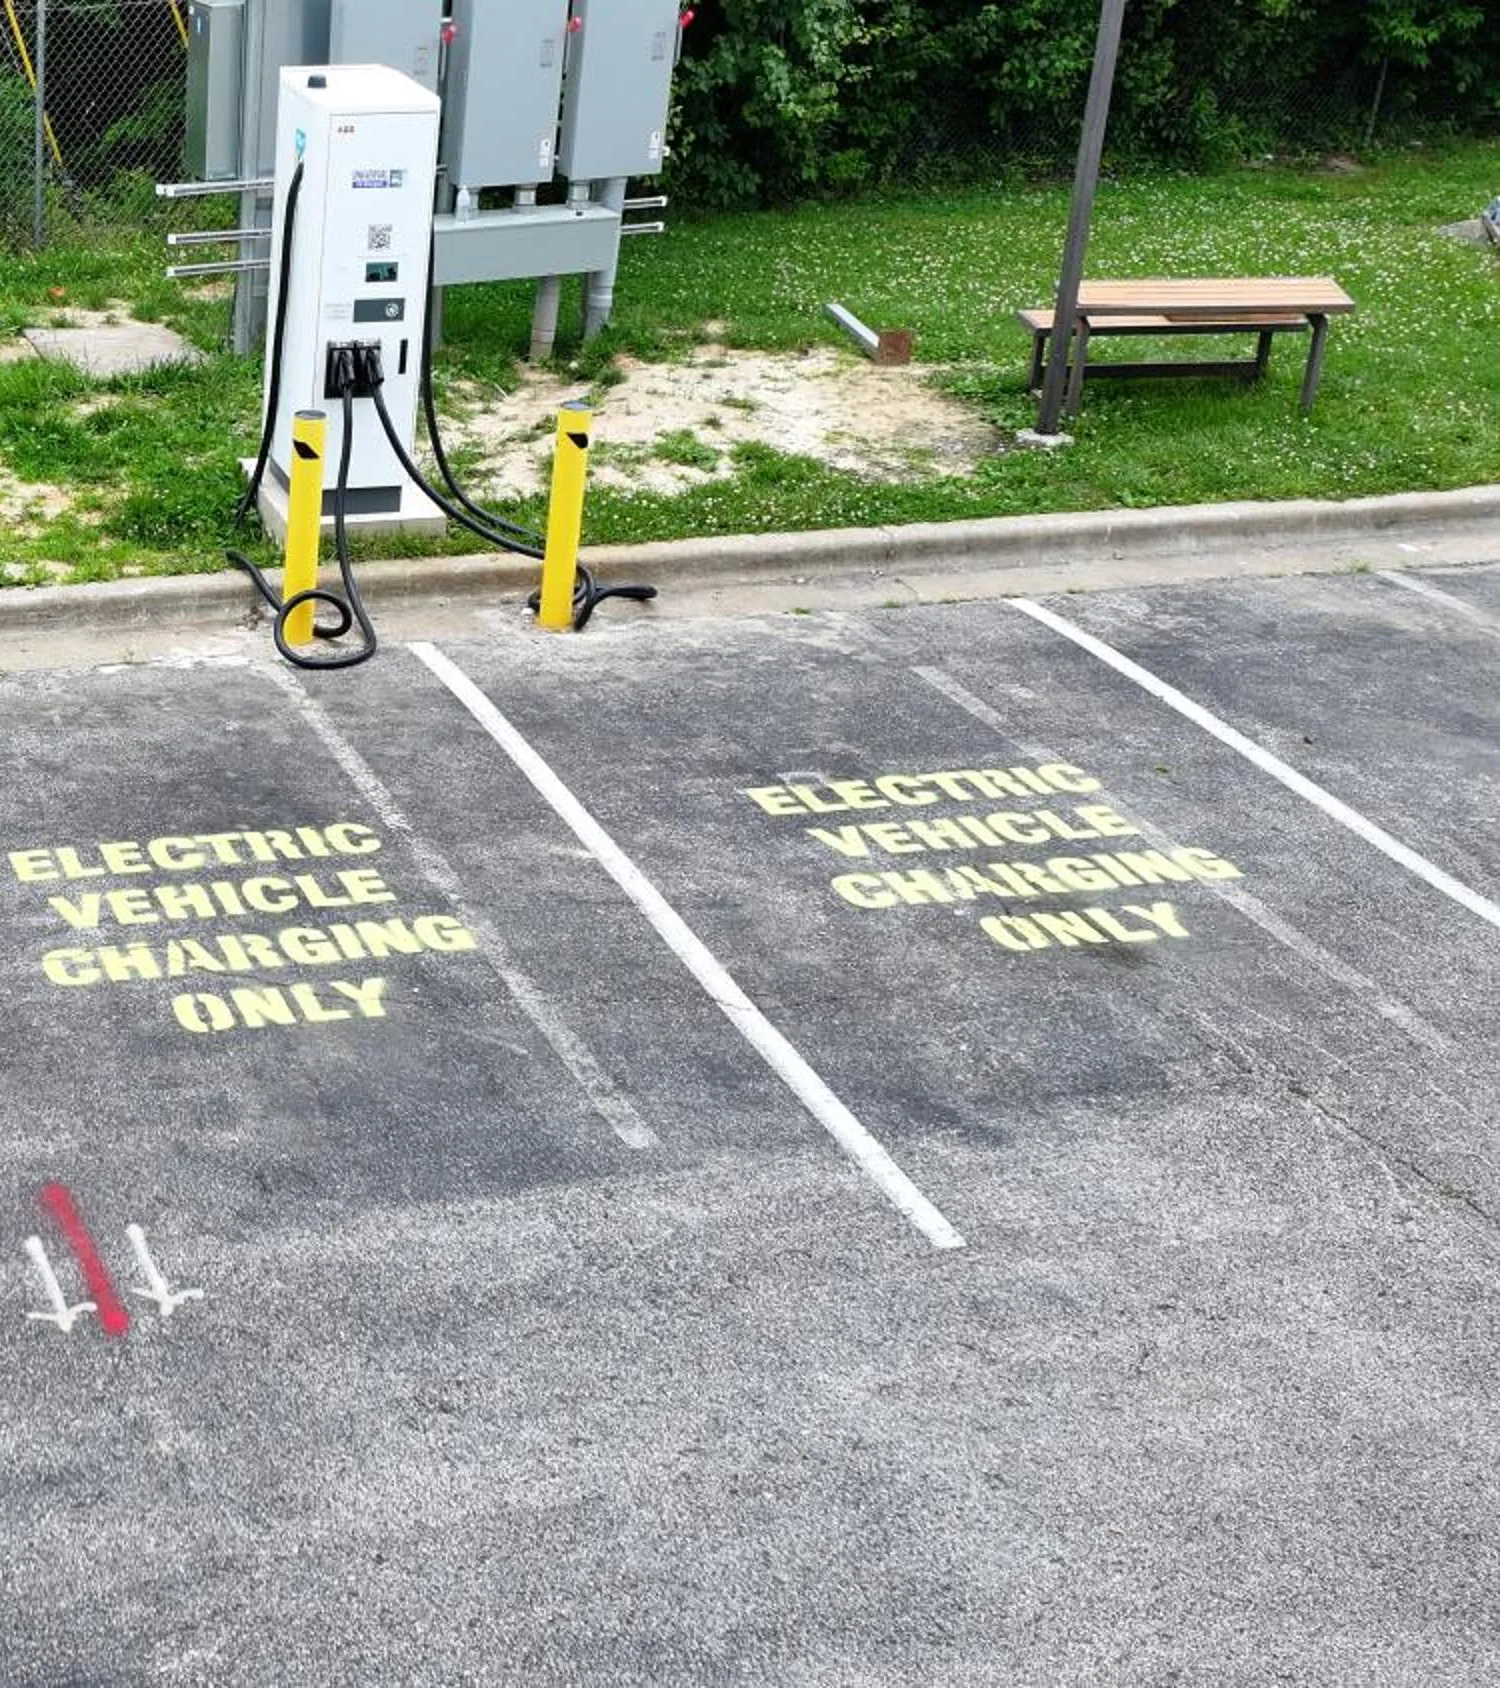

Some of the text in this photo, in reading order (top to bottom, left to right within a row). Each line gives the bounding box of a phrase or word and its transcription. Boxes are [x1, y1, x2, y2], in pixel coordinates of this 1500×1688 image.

[742, 762, 1104, 816] ELECTRIC
[7, 822, 383, 882] ELECTRIC
[806, 805, 1142, 858] VEHICLE
[47, 868, 398, 930] VEHICLE
[830, 846, 1245, 910] CHARGING
[40, 914, 479, 987] CHARGING
[978, 901, 1190, 951] ONLY
[169, 977, 389, 1034] ONLY
